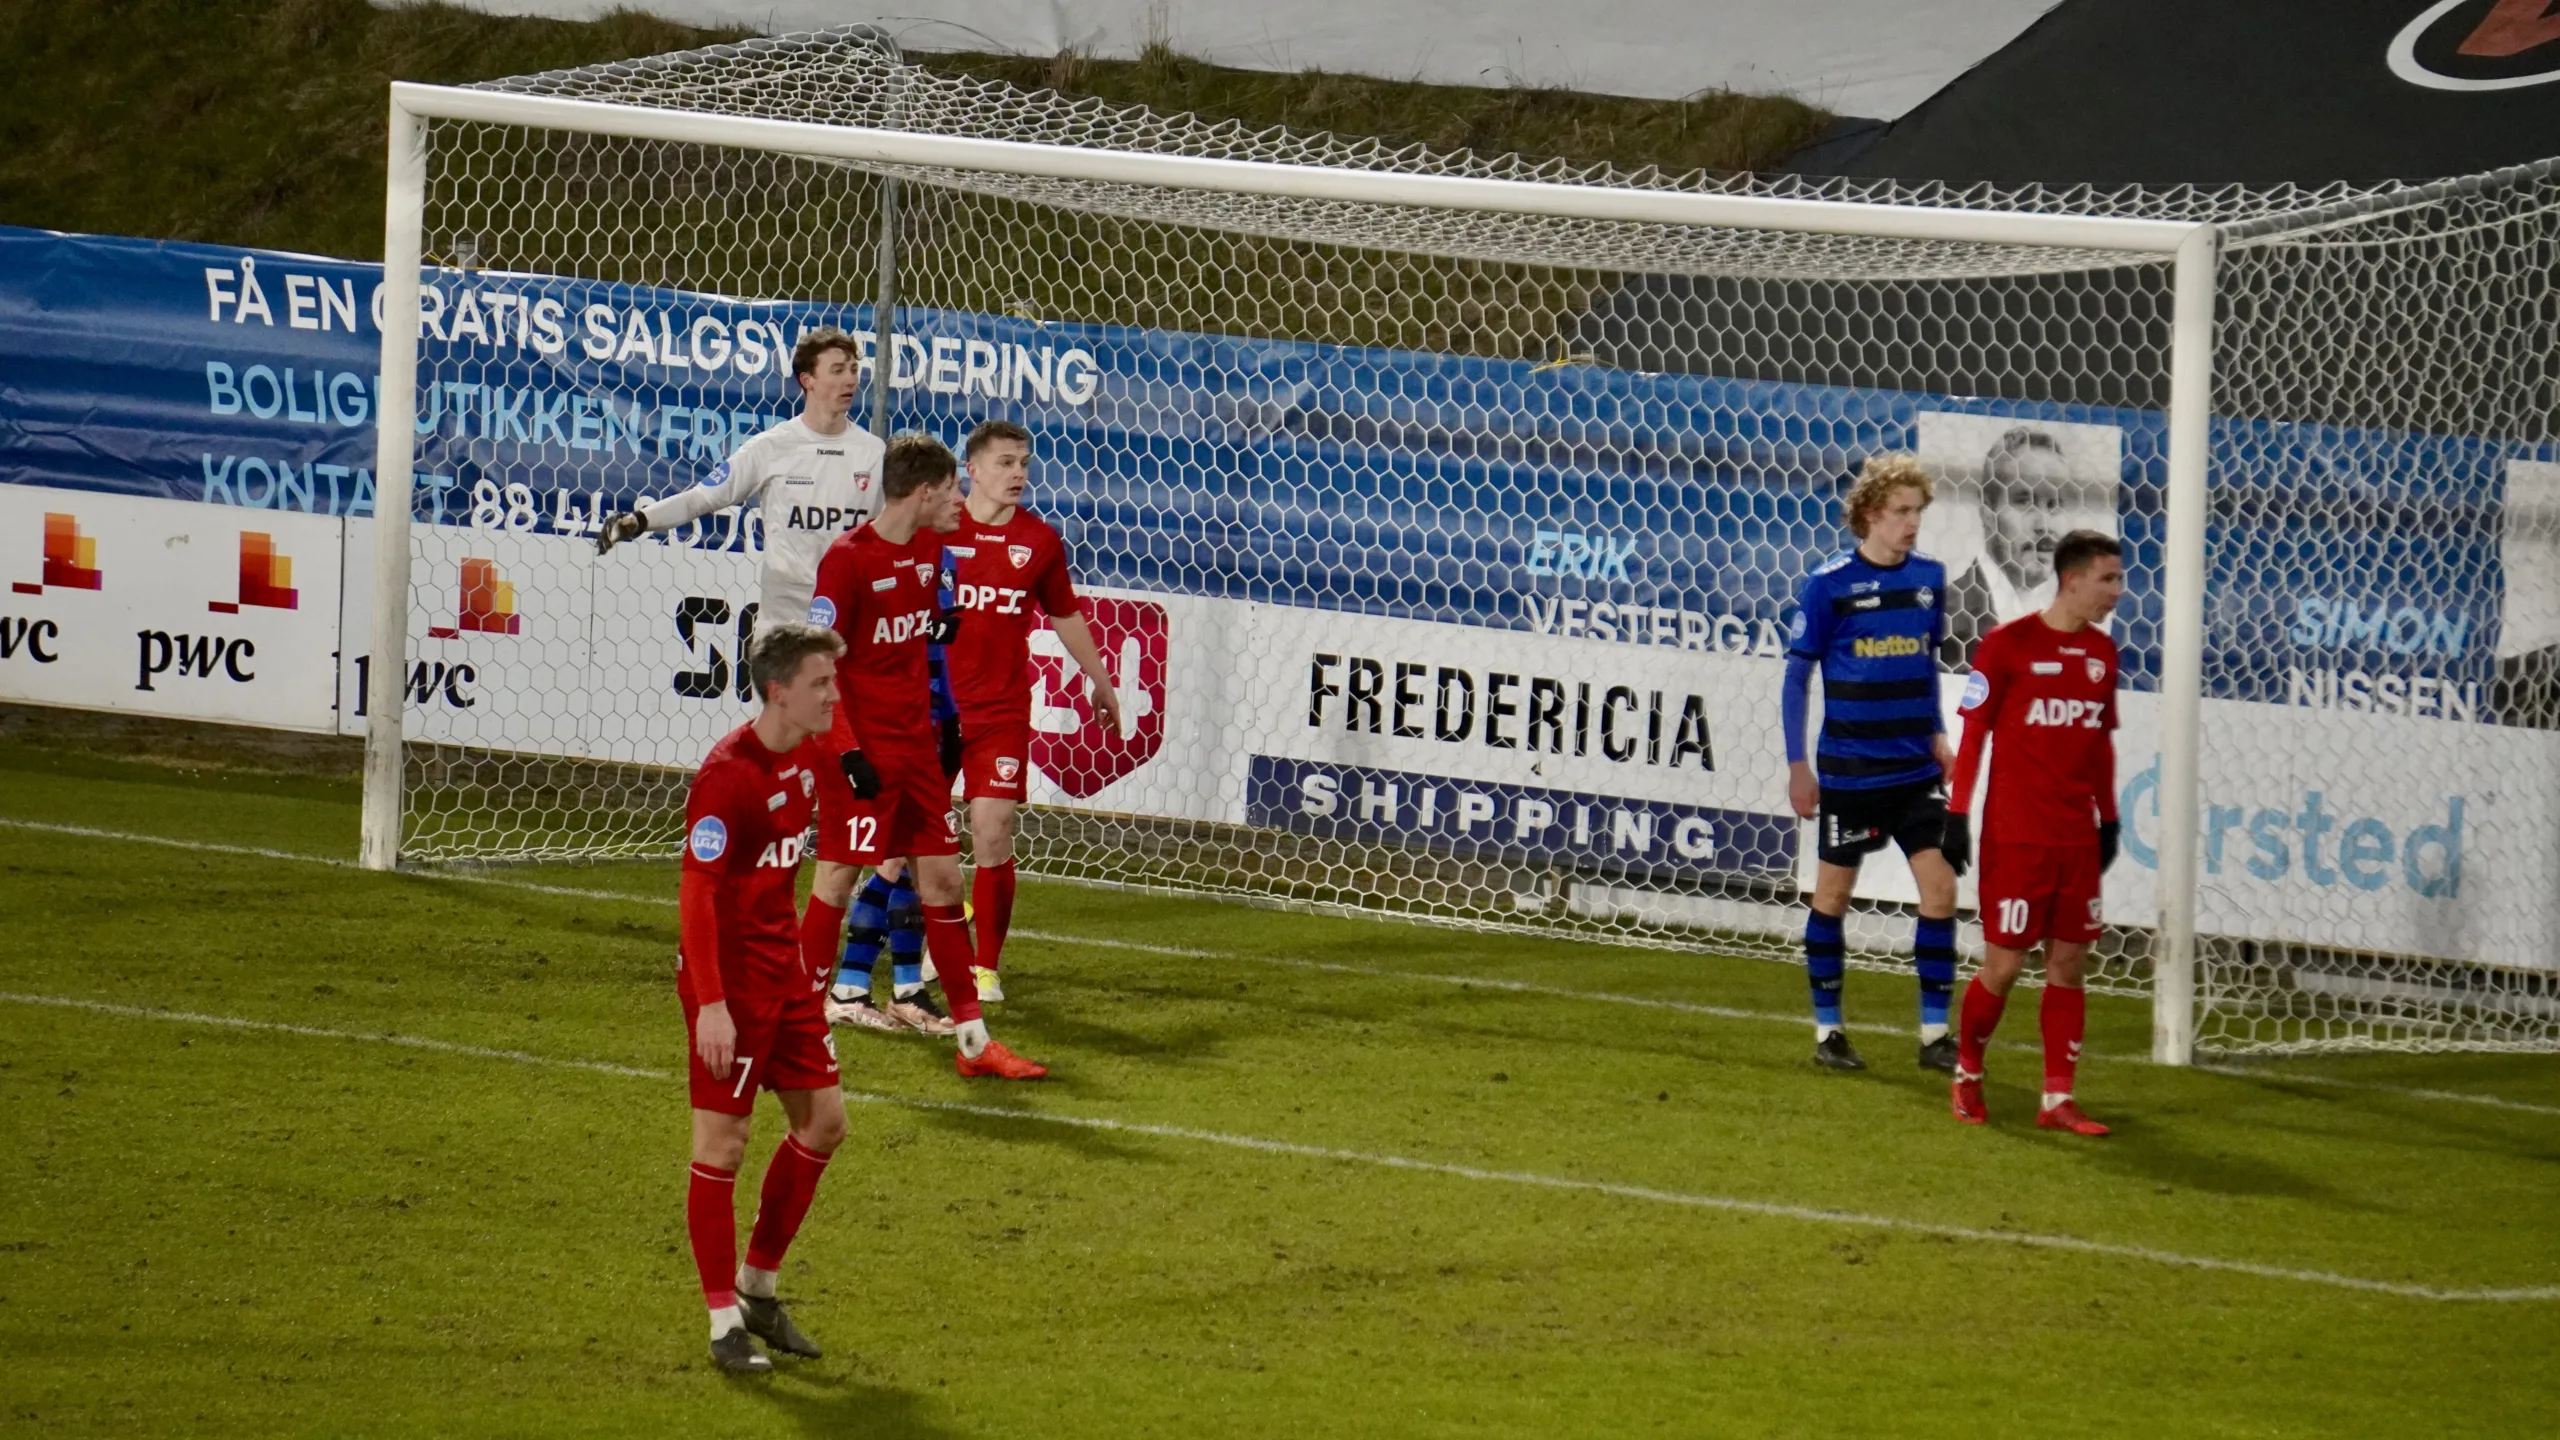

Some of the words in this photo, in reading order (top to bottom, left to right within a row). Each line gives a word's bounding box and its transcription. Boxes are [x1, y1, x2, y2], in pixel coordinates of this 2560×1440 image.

[205, 256, 274, 327] FÅ
[285, 274, 356, 333] EN
[371, 281, 566, 354] RATIS
[582, 303, 1098, 405] SALGSVRDERING
[206, 361, 642, 454] BOLIGUTIKKEN
[202, 453, 454, 525] KONTAT
[471, 479, 539, 533] 88
[1526, 530, 1638, 583] ERIK
[0, 616, 59, 663] wc
[1523, 595, 1784, 660] VESTERGA
[1854, 635, 1920, 658] Netto
[2289, 597, 2470, 658] SIMON
[135, 629, 255, 691] pwc
[1308, 652, 1715, 772] FREDERICIA
[2289, 665, 2477, 723] NISSEN
[847, 816, 877, 852] 12
[1301, 774, 1715, 859] SHIPPING
[1997, 898, 2030, 935] 10
[732, 1056, 753, 1099] 7
